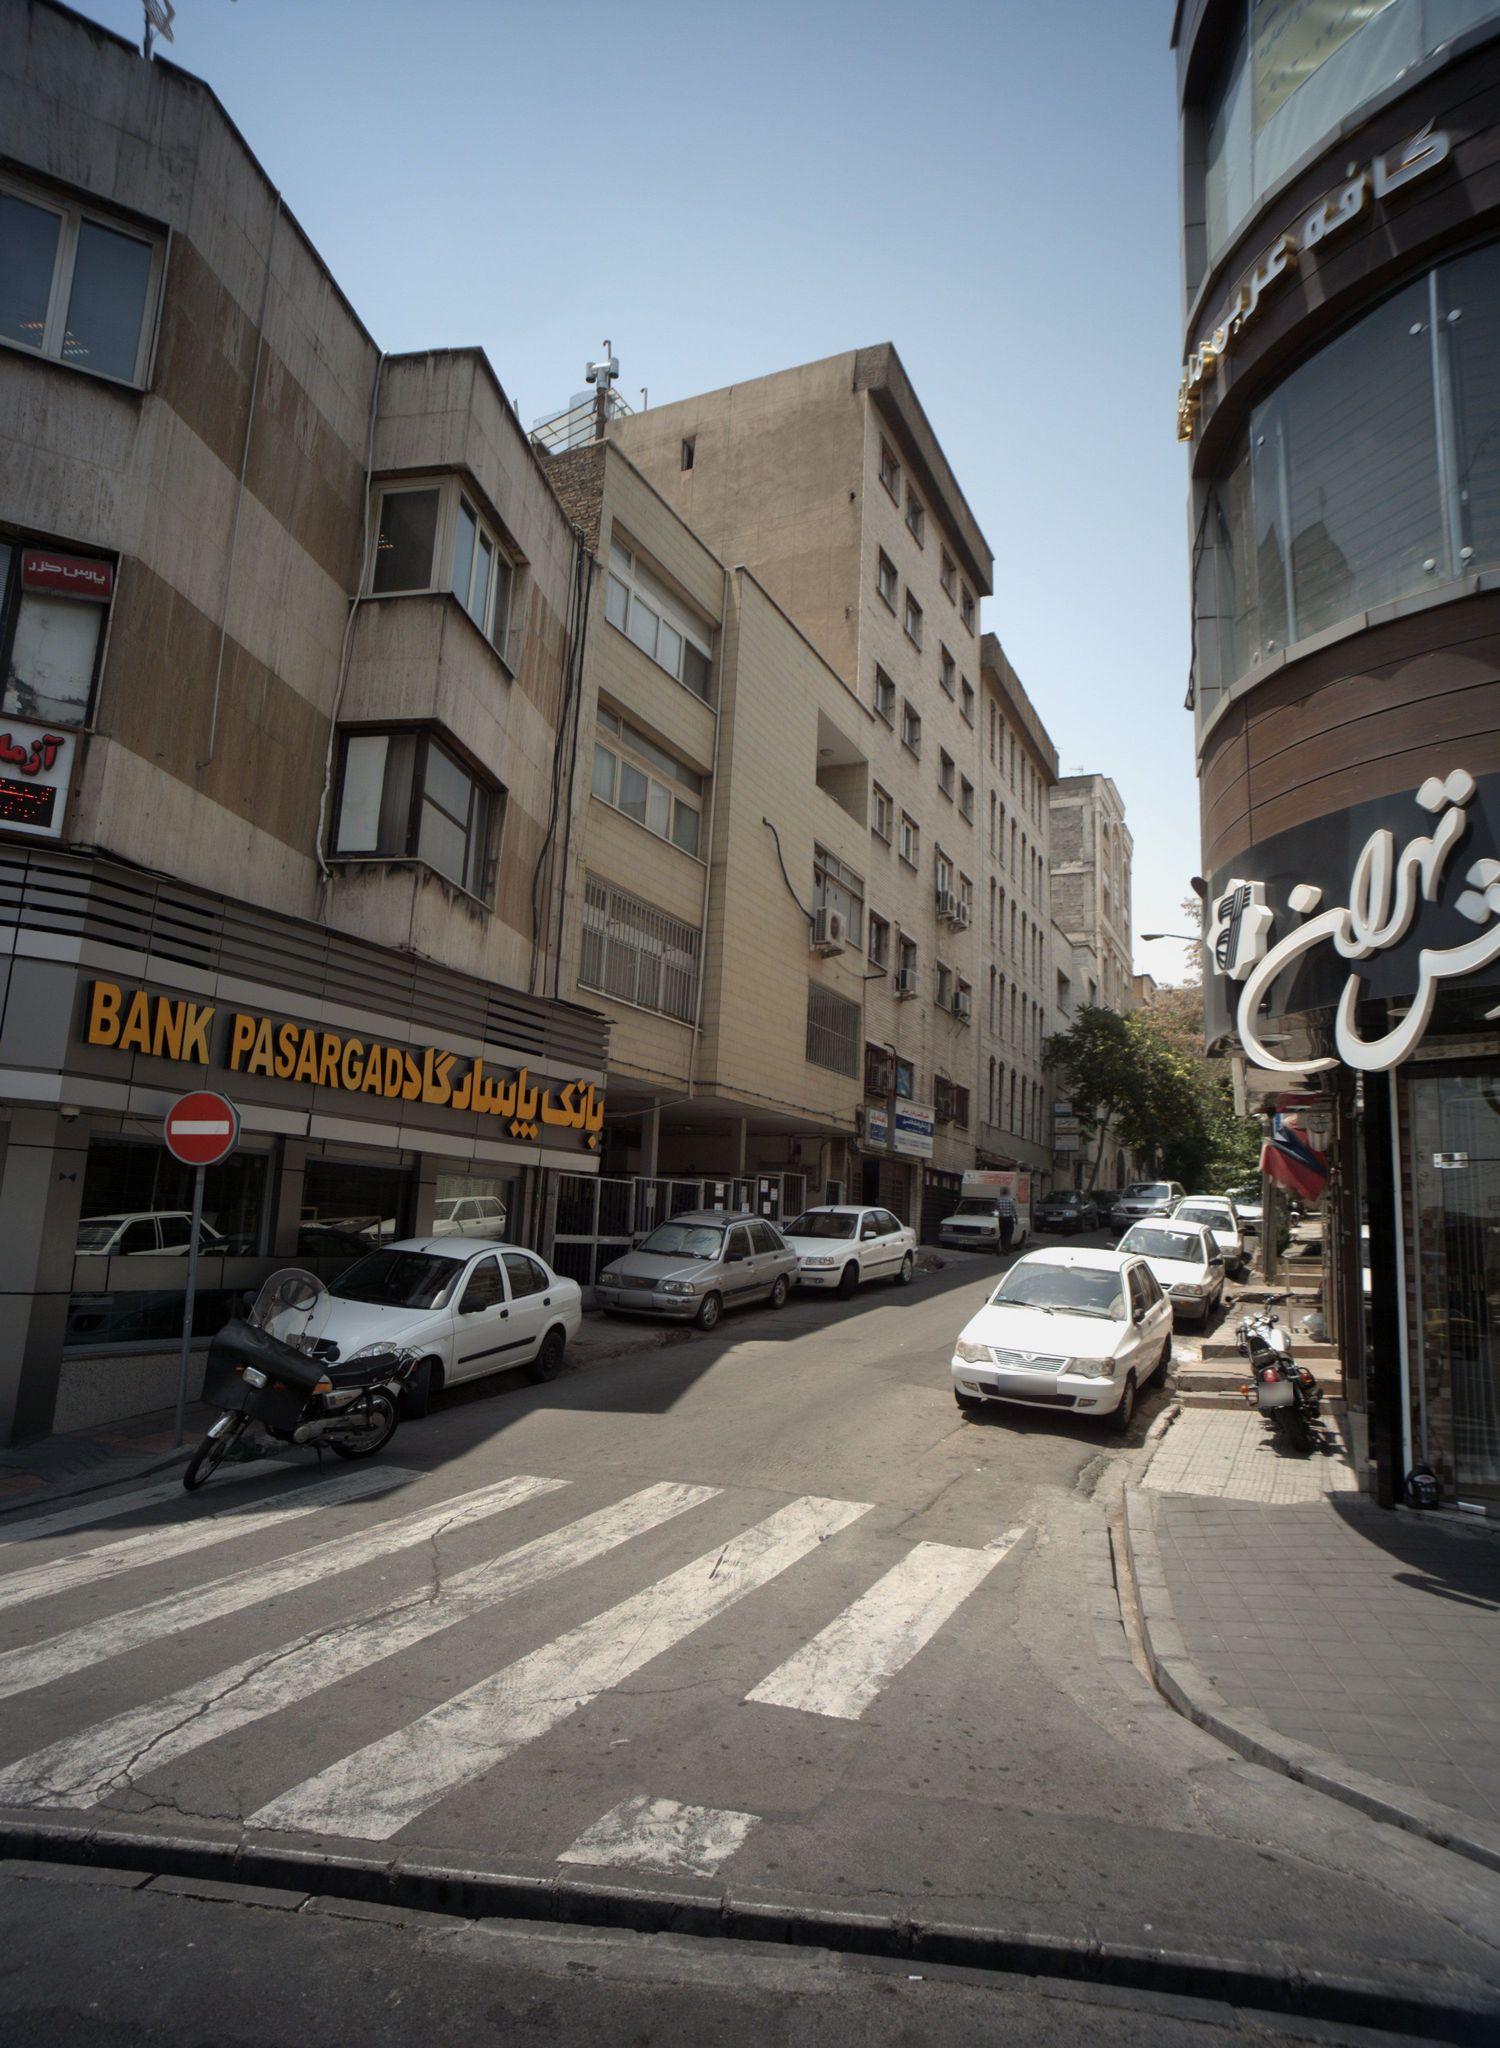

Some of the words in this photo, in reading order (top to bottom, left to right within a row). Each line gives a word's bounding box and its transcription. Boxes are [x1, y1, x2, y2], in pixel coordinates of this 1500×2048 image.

[63, 566, 106, 585] پارس
[85, 980, 216, 1065] BANK
[227, 1012, 405, 1099] PASARGAD
[402, 1045, 539, 1140] پاسارگاد
[541, 1079, 604, 1150] بانک
